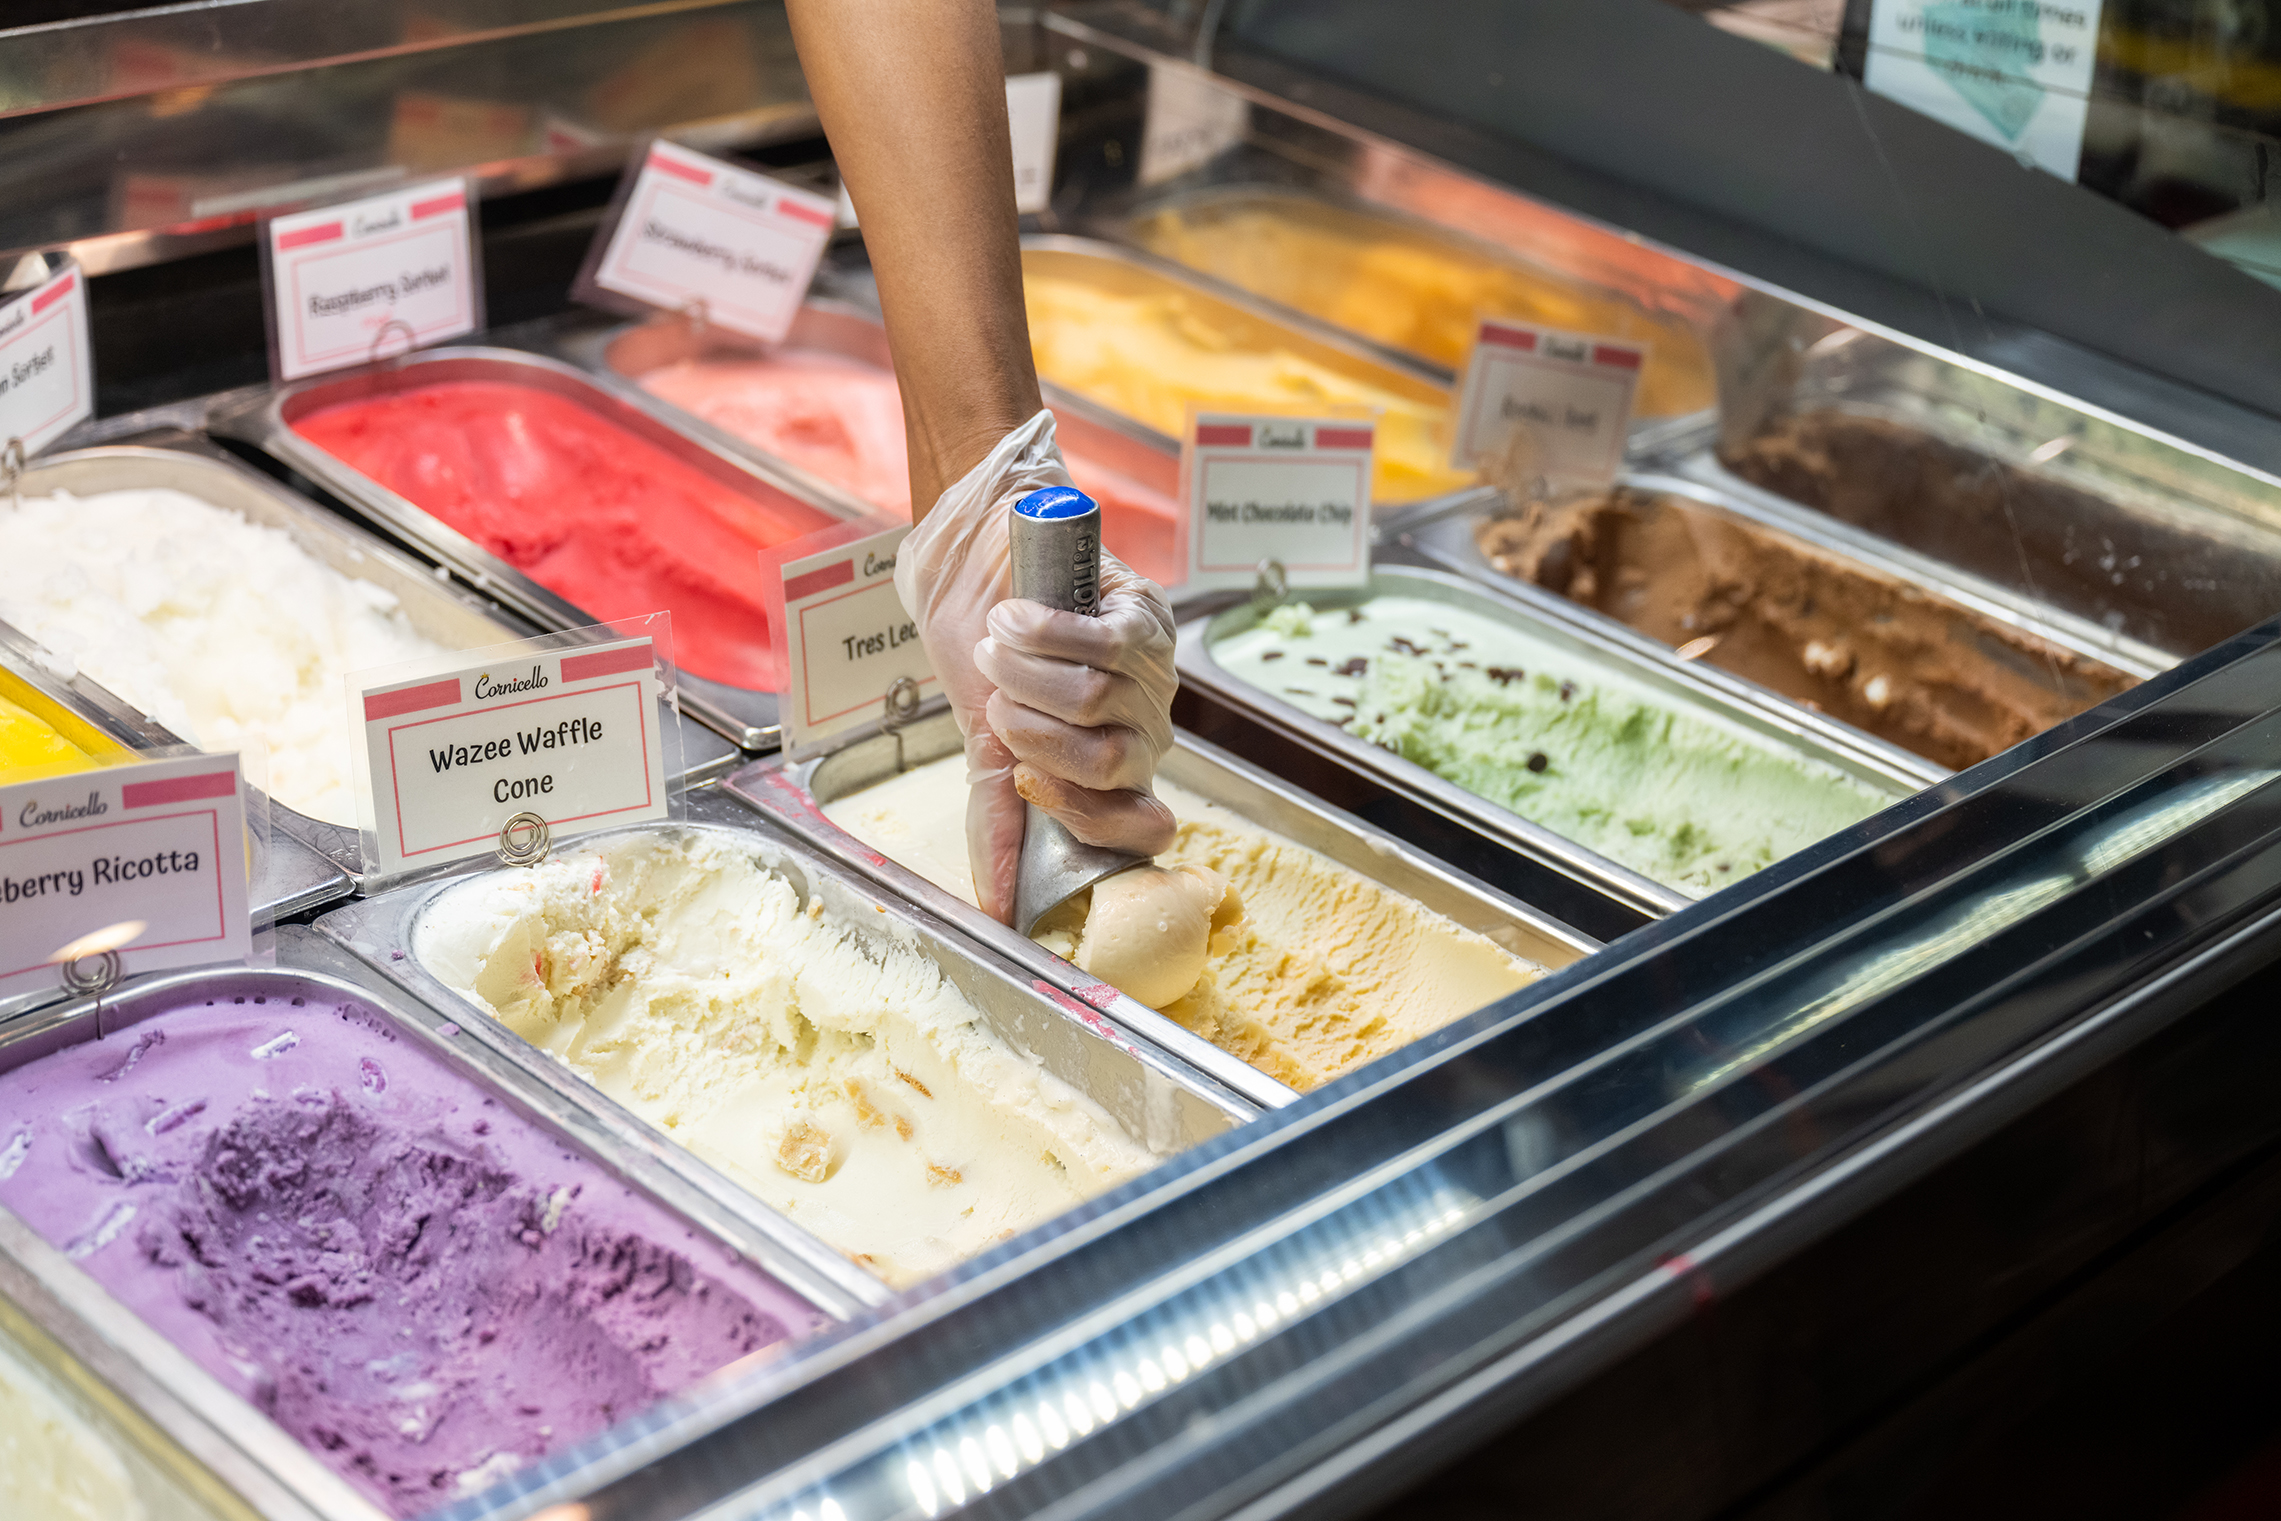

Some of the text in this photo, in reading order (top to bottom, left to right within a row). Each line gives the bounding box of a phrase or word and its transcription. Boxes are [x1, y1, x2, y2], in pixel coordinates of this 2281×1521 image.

[307, 265, 450, 319] Raspberry Sorbet
[11, 345, 55, 389] Sorbet
[1206, 501, 1352, 527] Mint Chocolate Chip
[842, 621, 919, 661] Tres Lec
[474, 665, 549, 700] Cornicello
[429, 717, 603, 774] Wazee Waffle
[493, 774, 554, 803] Cone
[19, 791, 108, 828] Cornicello
[0, 850, 199, 904] berry Ricotta
